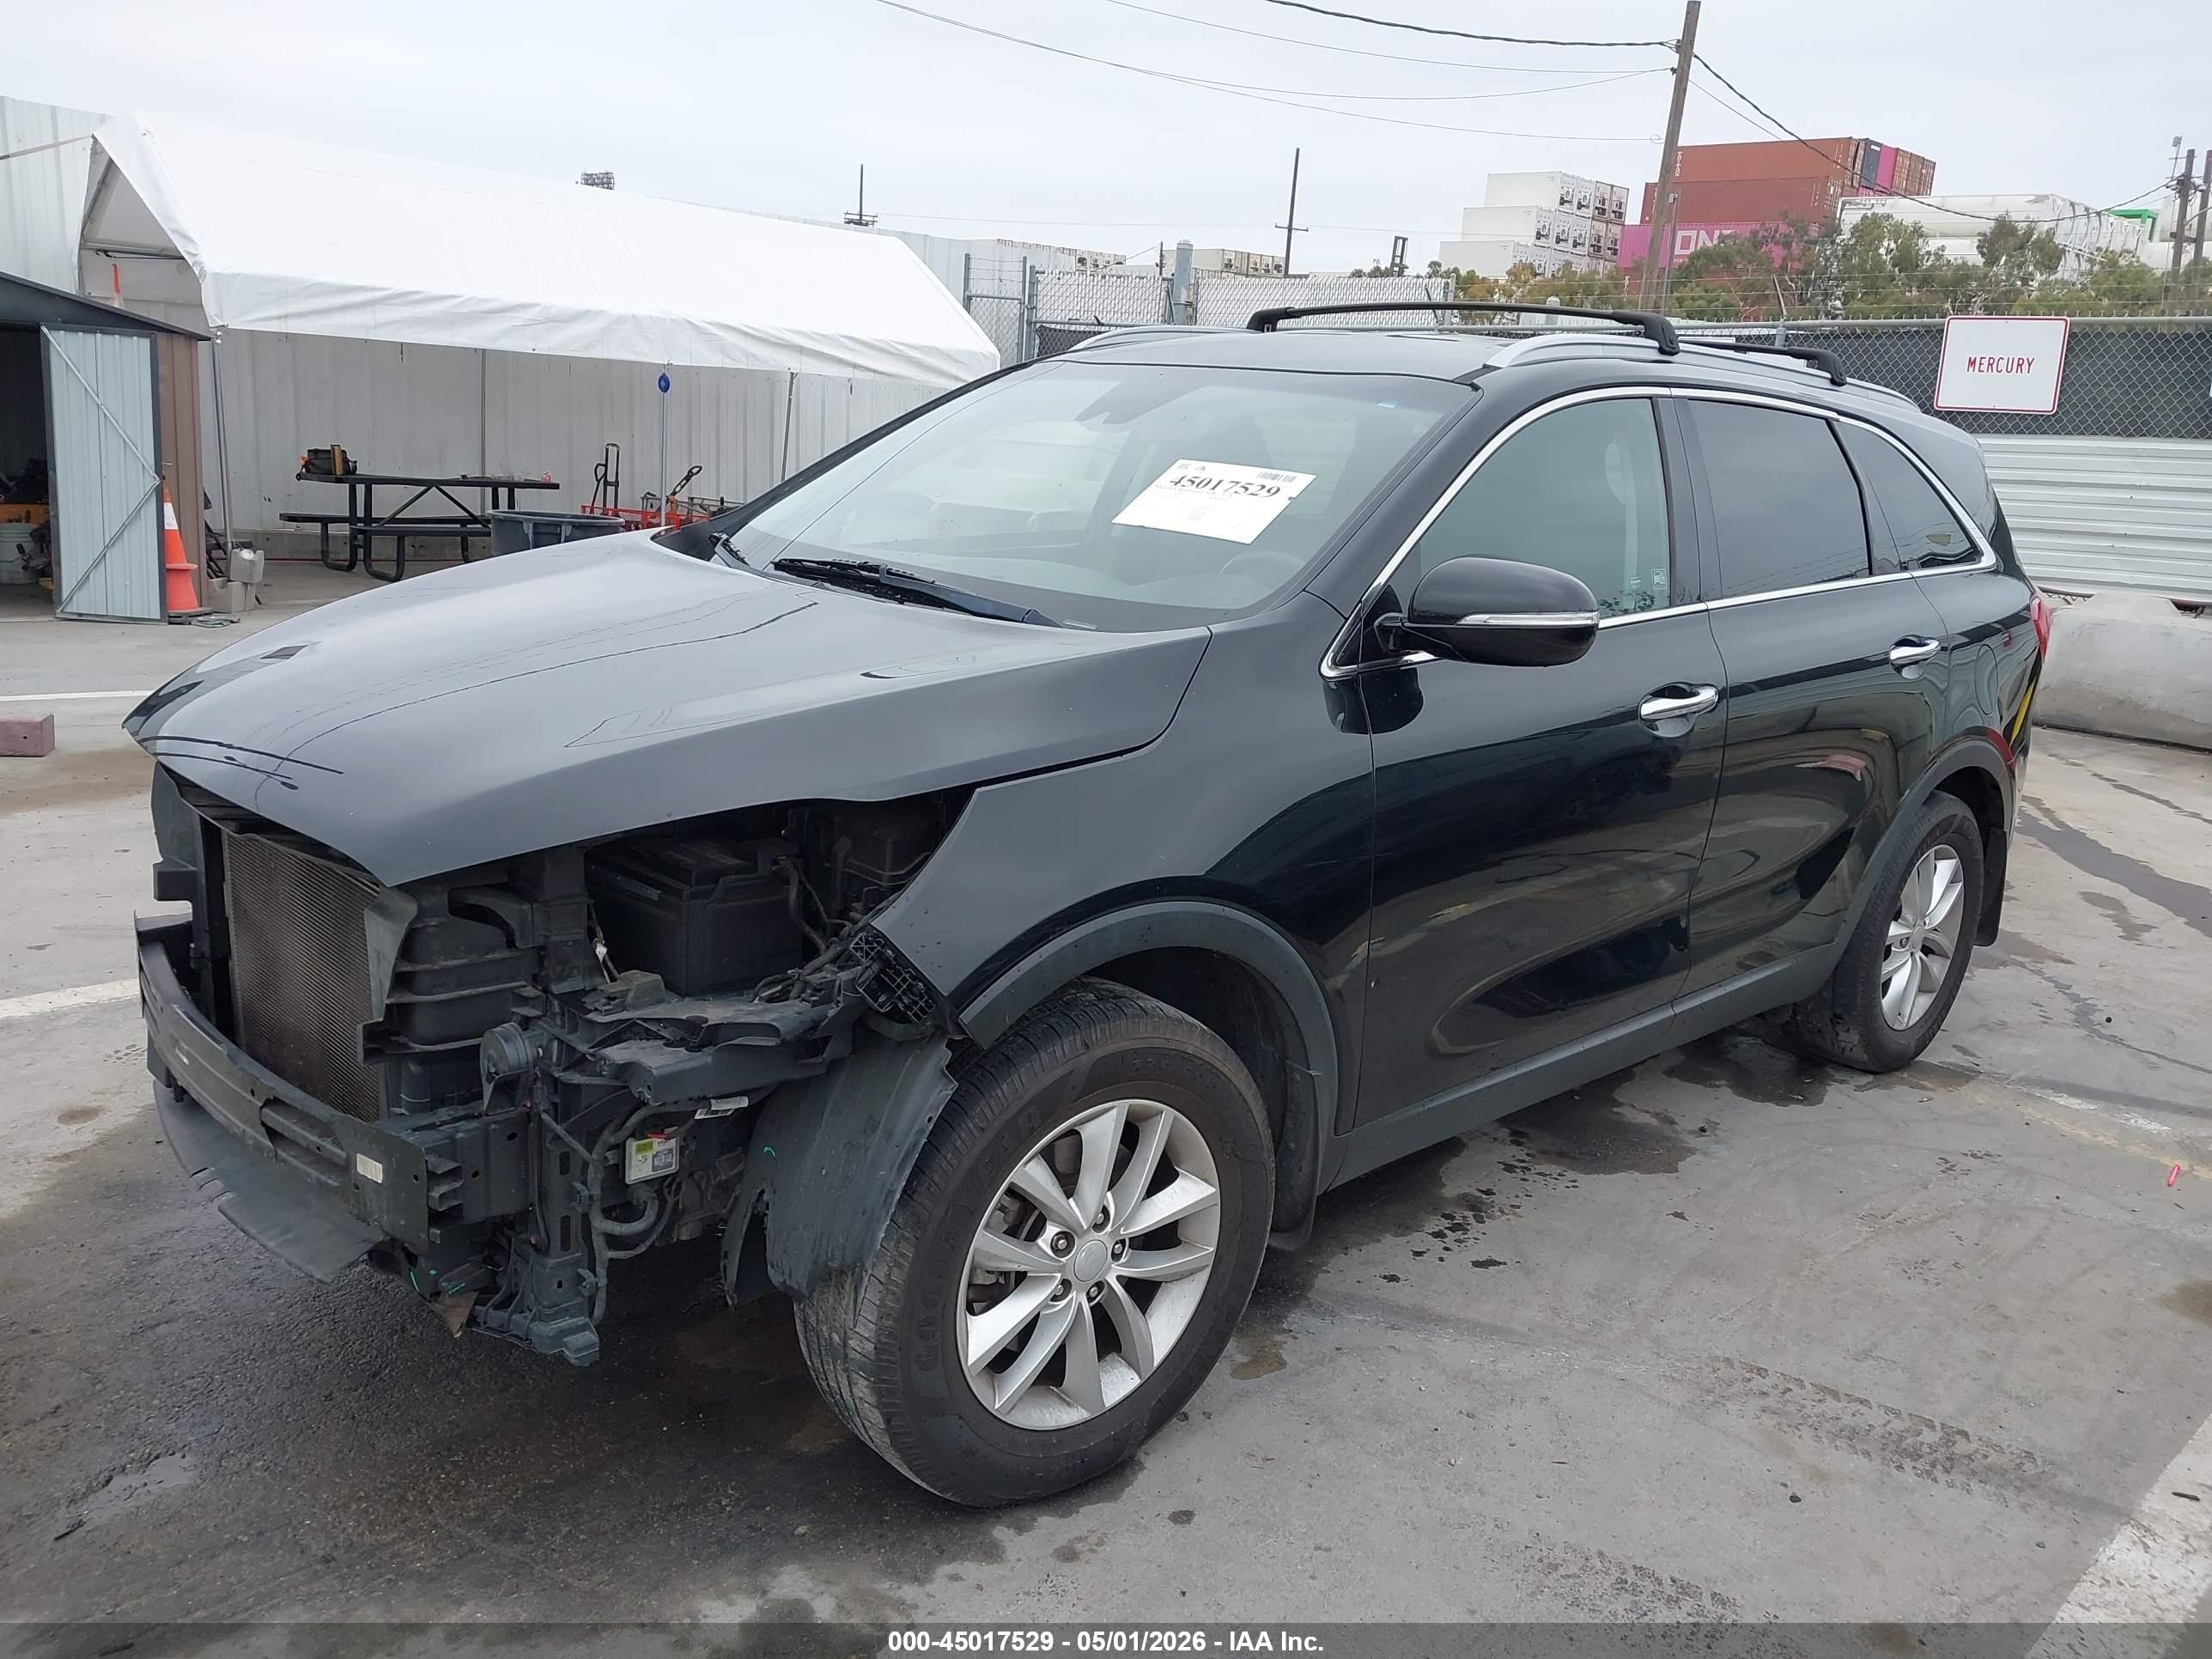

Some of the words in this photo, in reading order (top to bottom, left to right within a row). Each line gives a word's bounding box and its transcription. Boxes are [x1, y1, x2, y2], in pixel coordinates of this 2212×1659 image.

[1674, 229, 1740, 255] ON
[1966, 356, 2035, 374] MERCURY
[1169, 474, 1282, 498] 45017529
